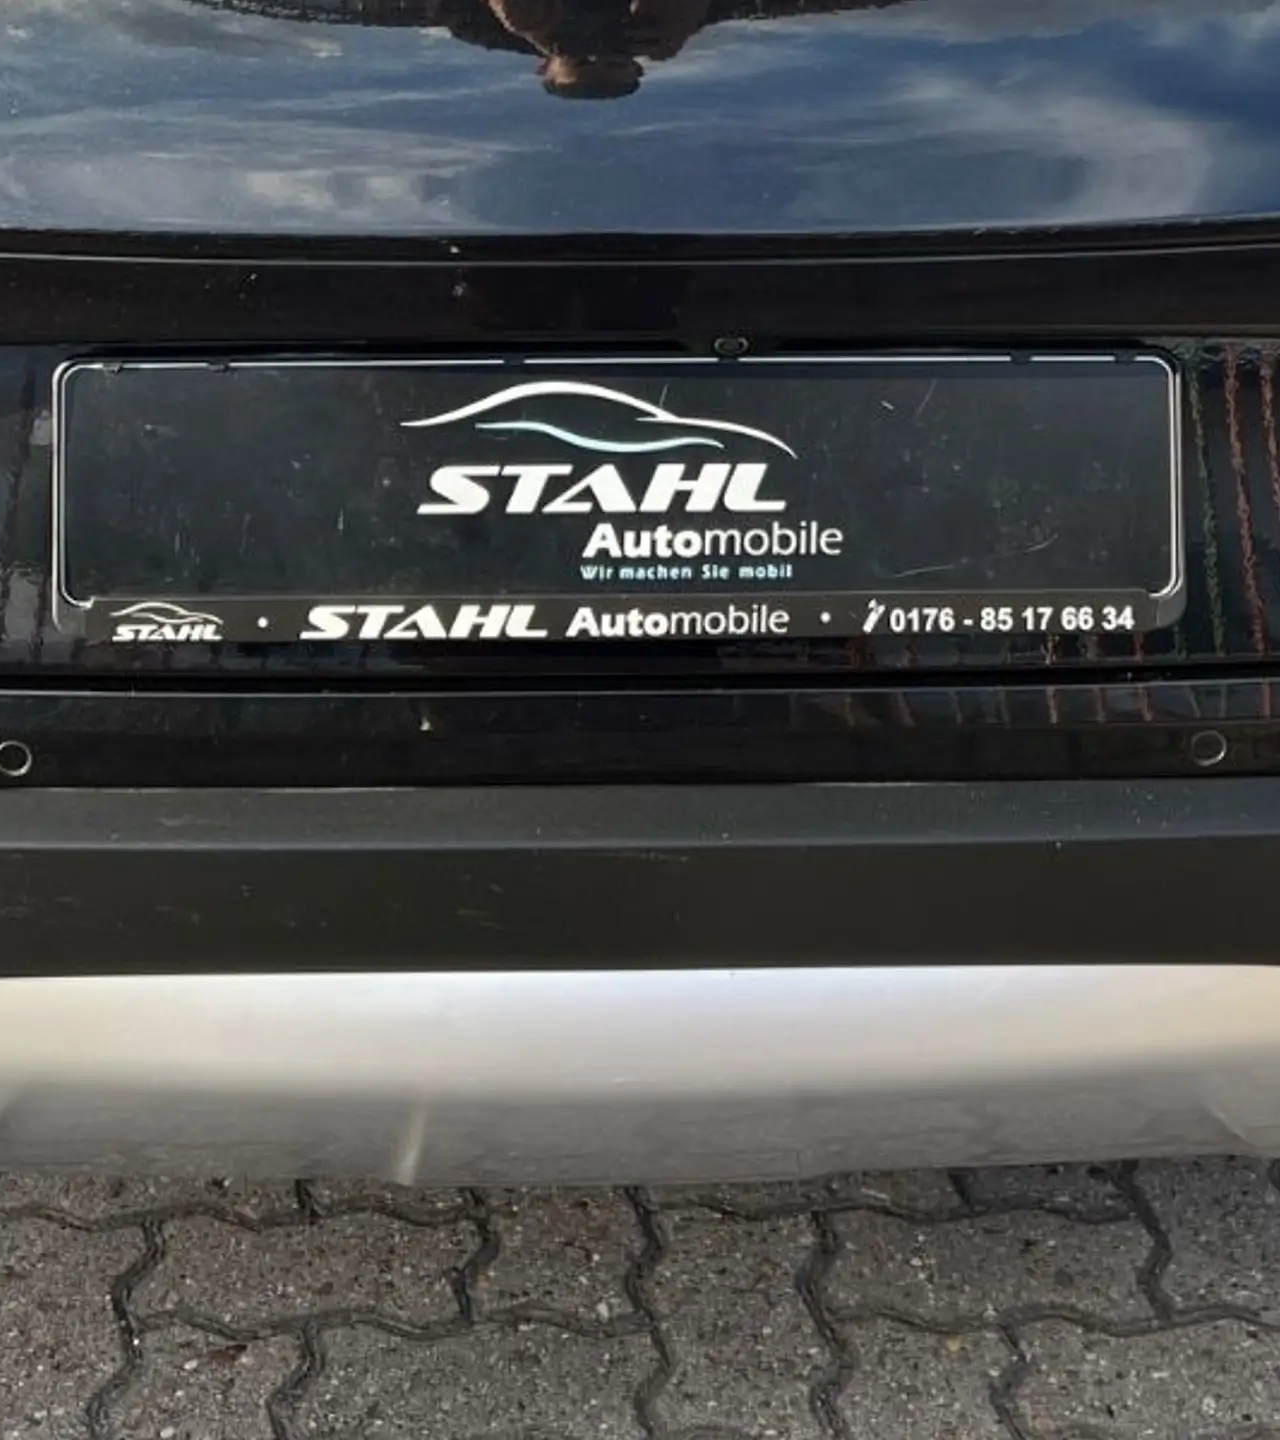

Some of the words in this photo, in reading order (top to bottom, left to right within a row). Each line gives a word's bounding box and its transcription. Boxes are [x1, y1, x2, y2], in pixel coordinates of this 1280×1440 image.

[416, 462, 788, 516] STAHL
[581, 520, 844, 559] Automobile
[580, 564, 614, 581] Wir
[619, 564, 692, 581] machen
[701, 564, 731, 580] Sie
[738, 563, 794, 580] mobil
[112, 623, 223, 643] STAHL
[299, 604, 548, 640] STAHL
[565, 603, 791, 637] Automobile
[889, 605, 957, 633] 0176
[980, 605, 1014, 631] 85
[1022, 605, 1053, 631] 17
[1060, 604, 1094, 631] 66
[1100, 603, 1136, 630] 34
